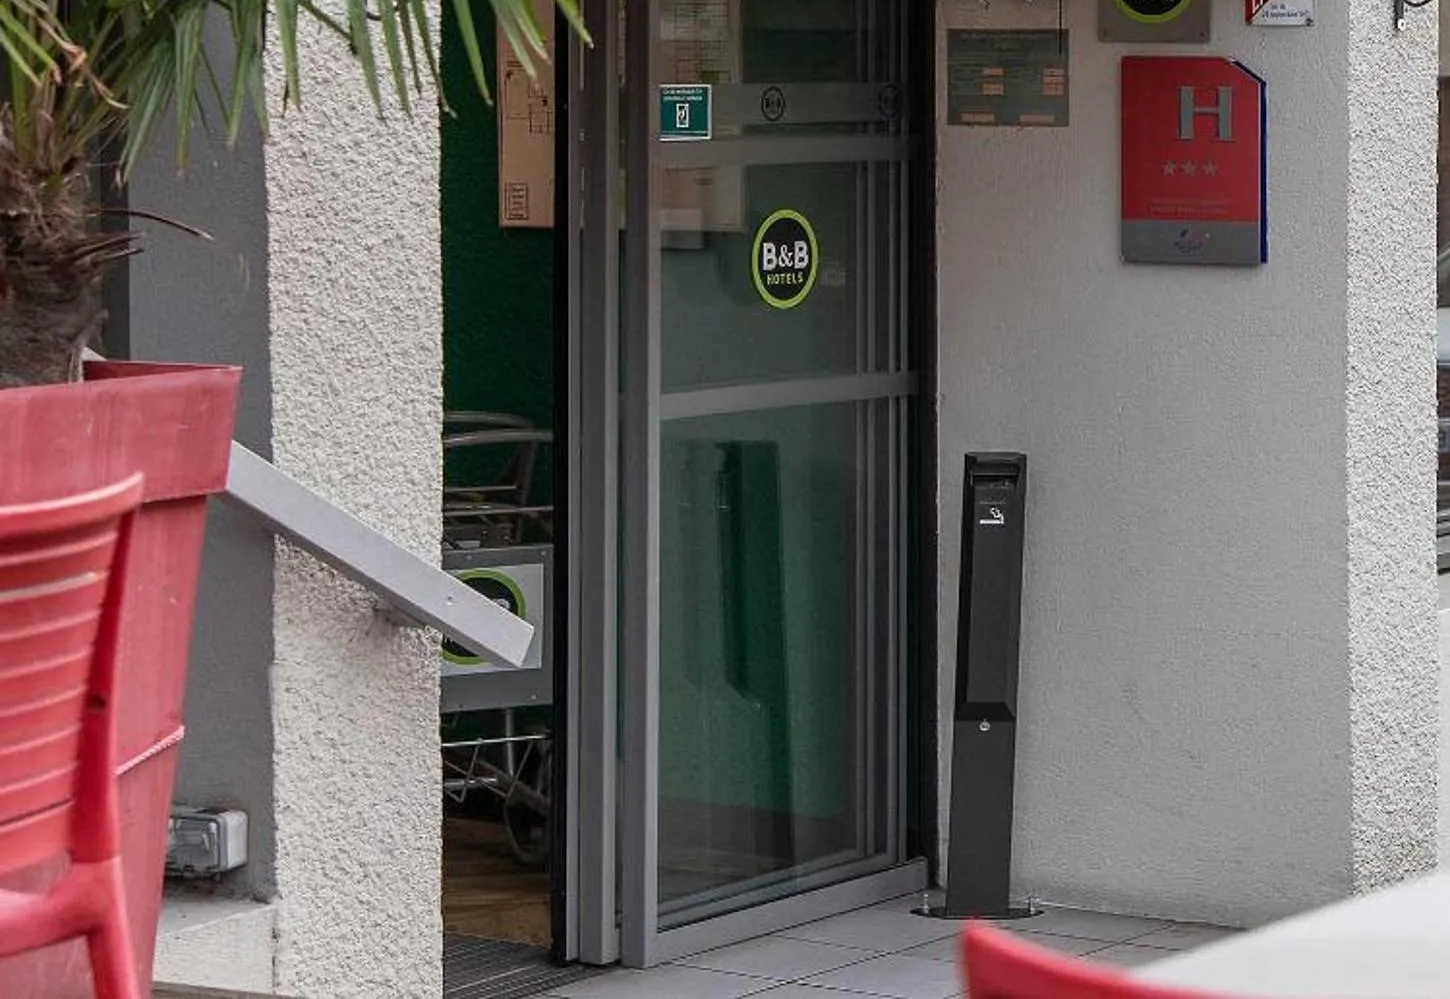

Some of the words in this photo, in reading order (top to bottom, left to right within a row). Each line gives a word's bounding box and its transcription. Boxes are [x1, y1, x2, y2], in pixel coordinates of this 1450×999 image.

[1177, 85, 1235, 142] H
[762, 240, 809, 271] B&B
[767, 271, 803, 286] HOTELS
